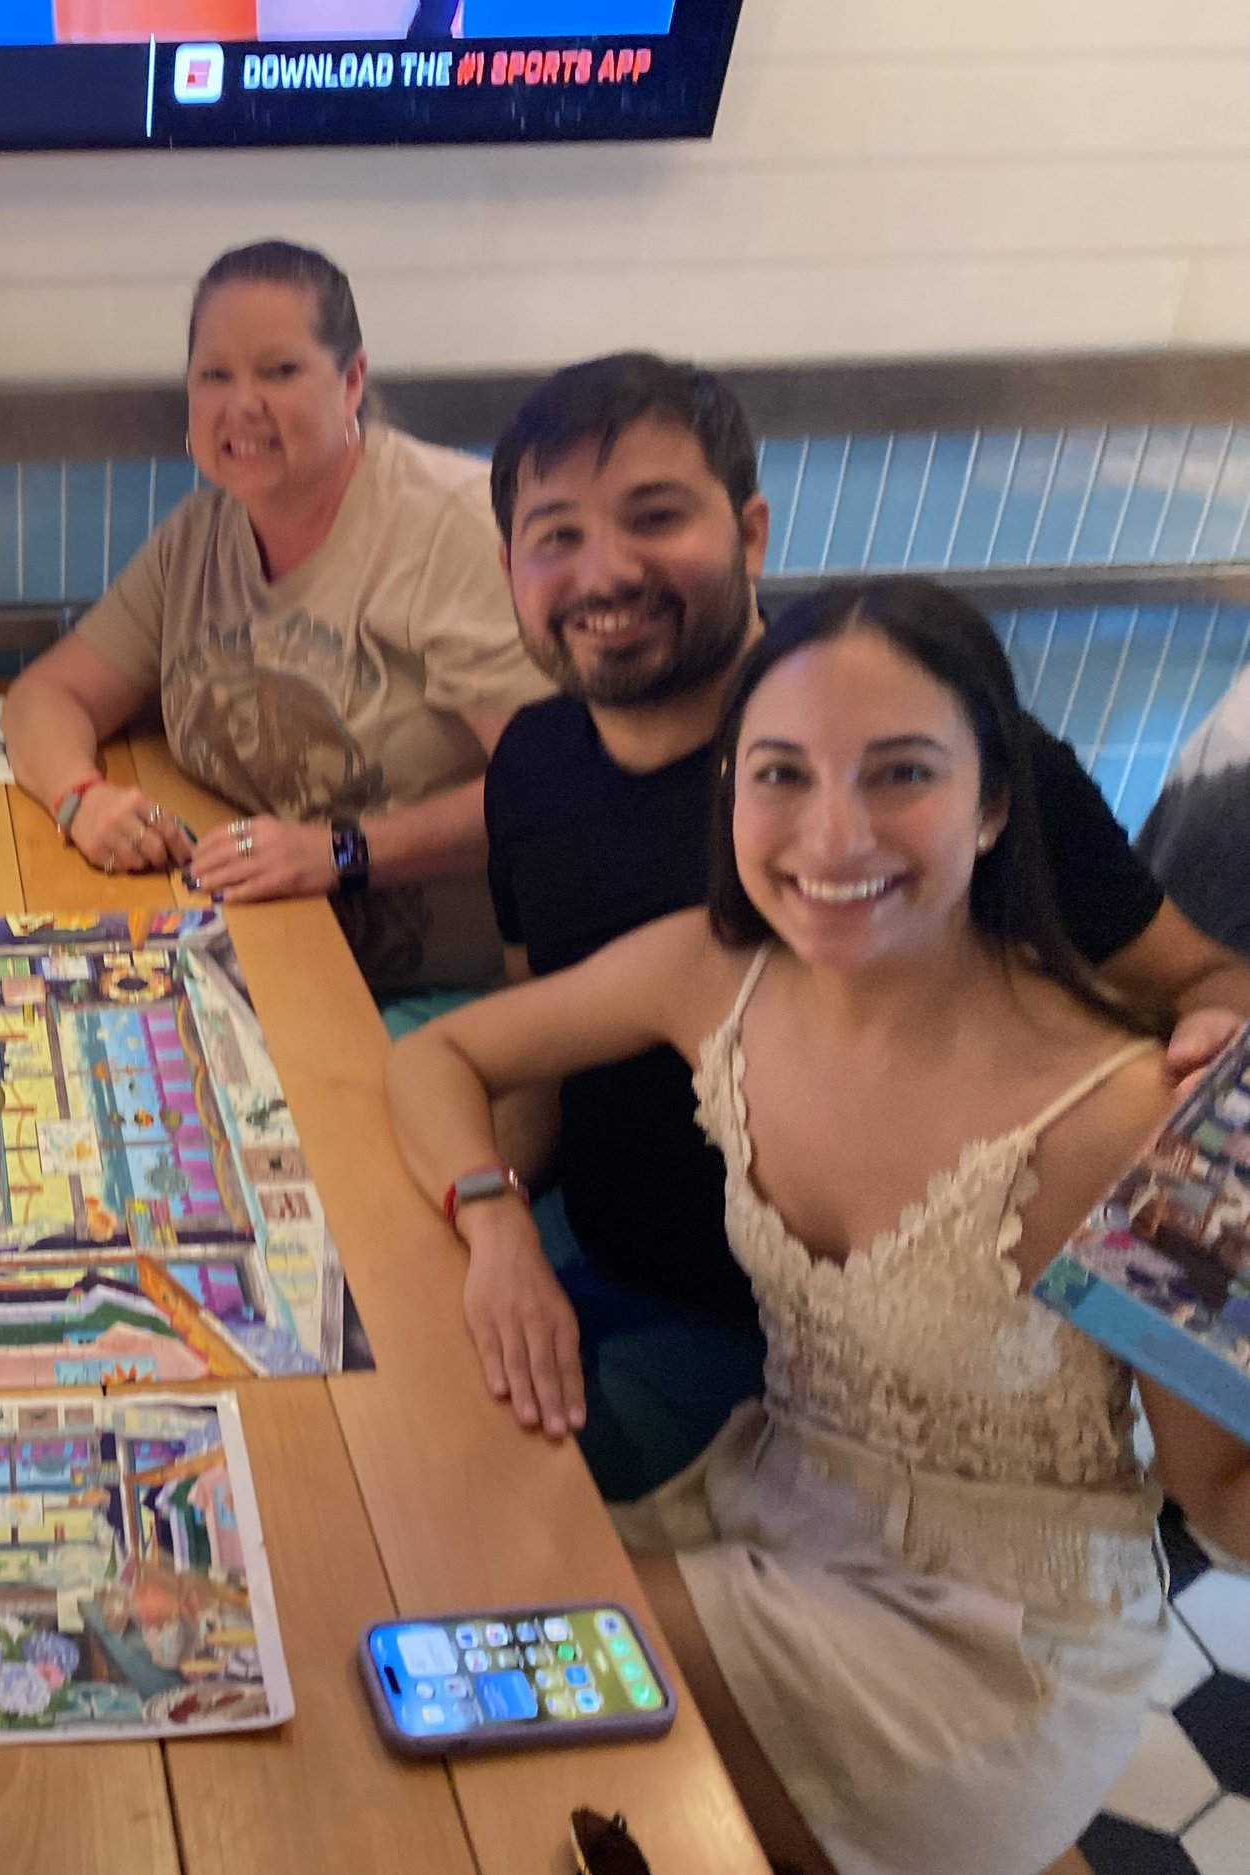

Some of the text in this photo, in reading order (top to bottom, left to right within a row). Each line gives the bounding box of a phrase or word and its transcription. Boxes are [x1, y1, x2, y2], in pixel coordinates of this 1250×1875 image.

[243, 48, 652, 89] DOWNLOAD THE #1 SPORTS APP
